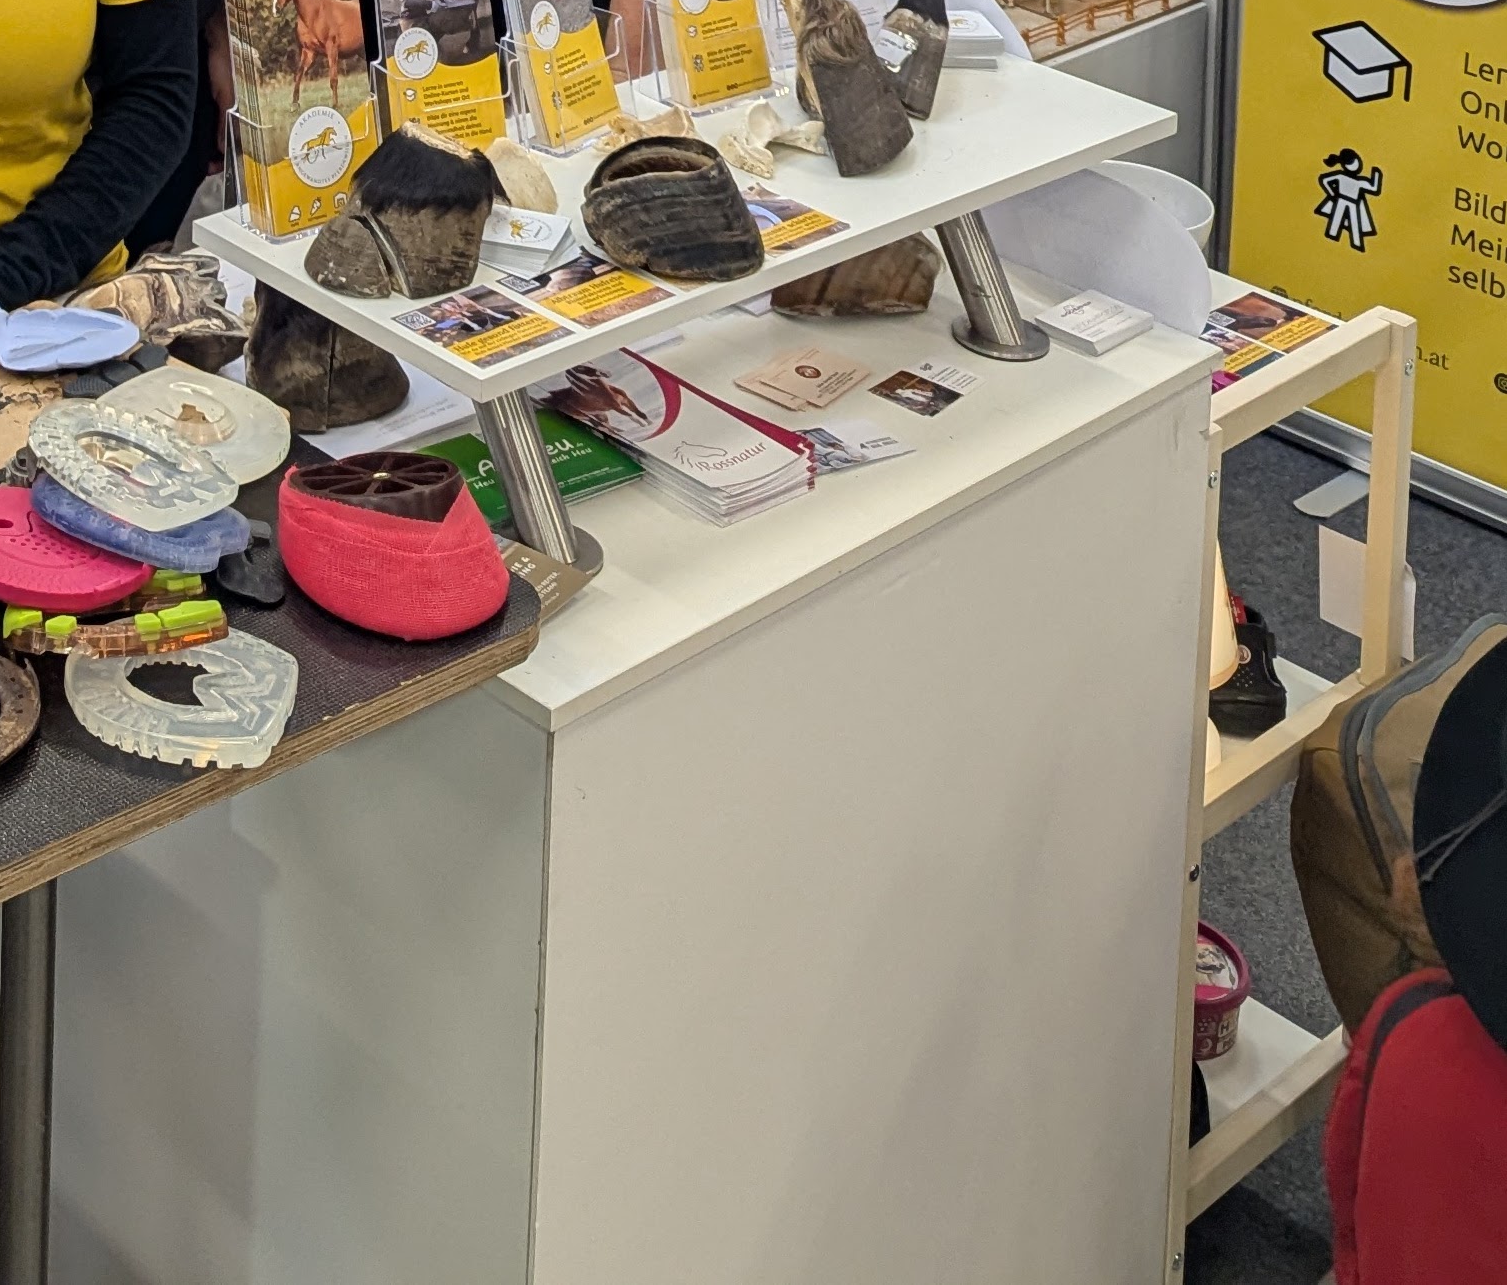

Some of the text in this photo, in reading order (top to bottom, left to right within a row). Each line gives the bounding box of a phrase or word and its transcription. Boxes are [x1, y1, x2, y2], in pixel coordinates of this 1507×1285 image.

[299, 110, 335, 128] AKADEMIE
[1458, 125, 1507, 162] Wo
[1455, 187, 1507, 224] Bild
[1451, 224, 1507, 264] Mei
[1448, 266, 1505, 298] selb
[573, 447, 592, 457] Heu
[695, 441, 766, 471] Rossnatur
[473, 479, 495, 490] Heu
